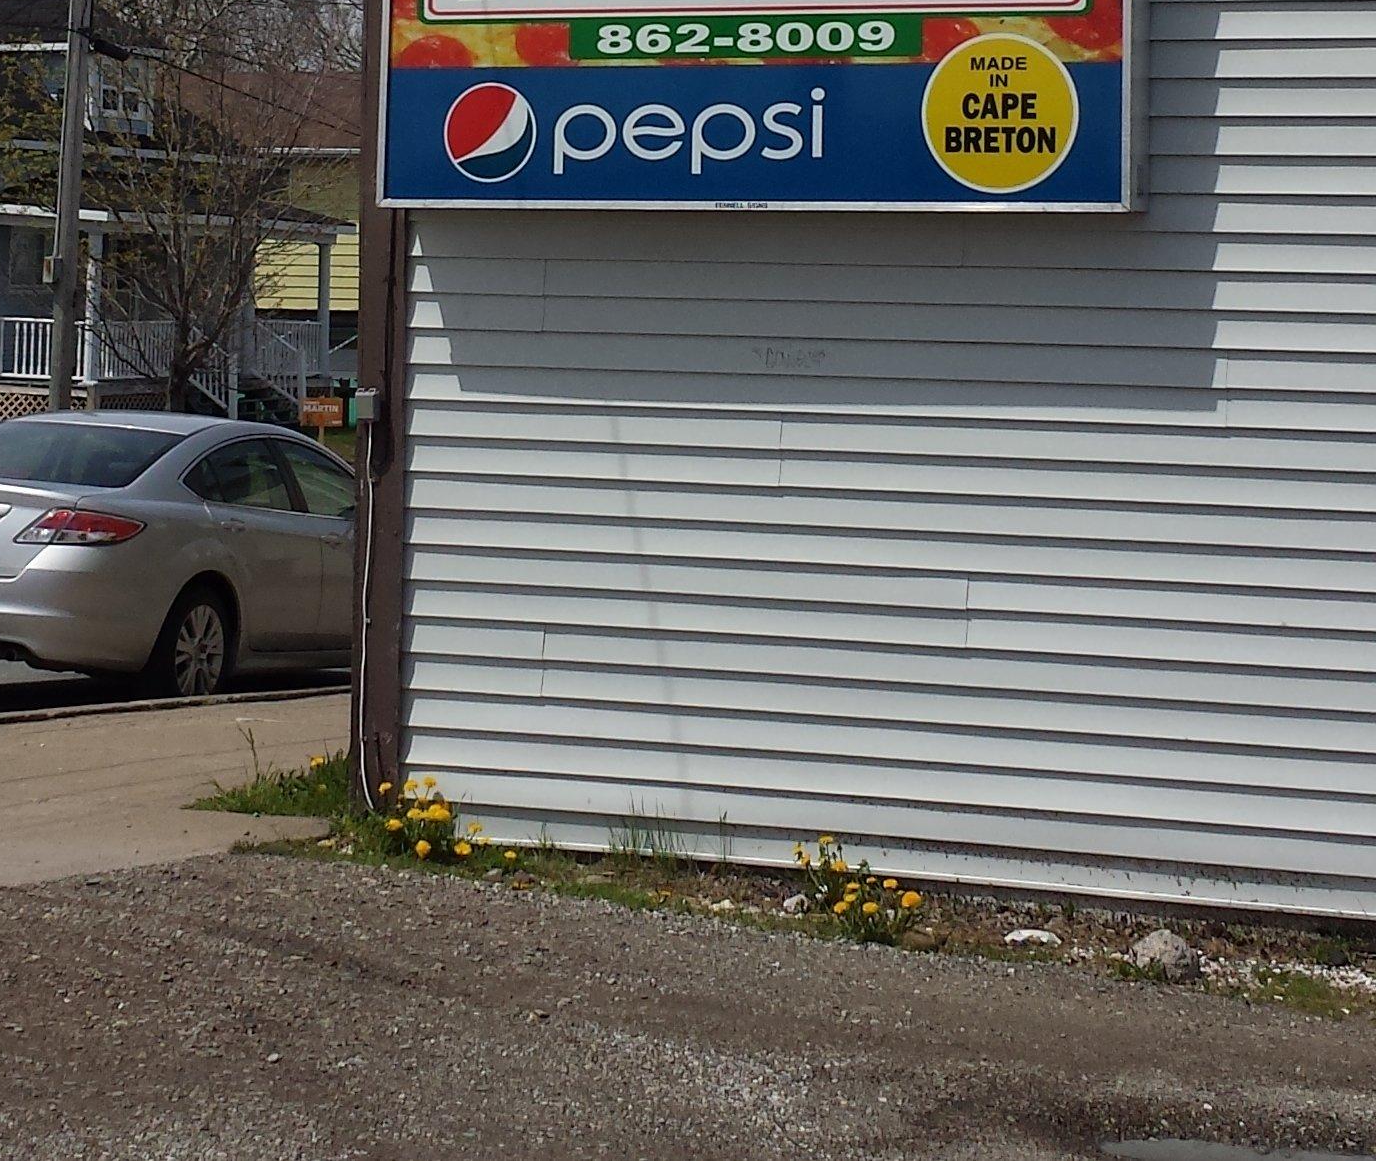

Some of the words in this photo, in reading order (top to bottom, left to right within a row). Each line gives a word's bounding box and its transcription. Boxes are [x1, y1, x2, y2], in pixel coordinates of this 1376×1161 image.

[596, 20, 896, 54] 862-8009
[970, 56, 1027, 71] MADE
[989, 74, 1008, 87] IN
[962, 92, 1037, 120] CAPE
[552, 87, 826, 175] pepsi
[944, 126, 1056, 154] BRETON
[303, 404, 339, 412] MARTIN
